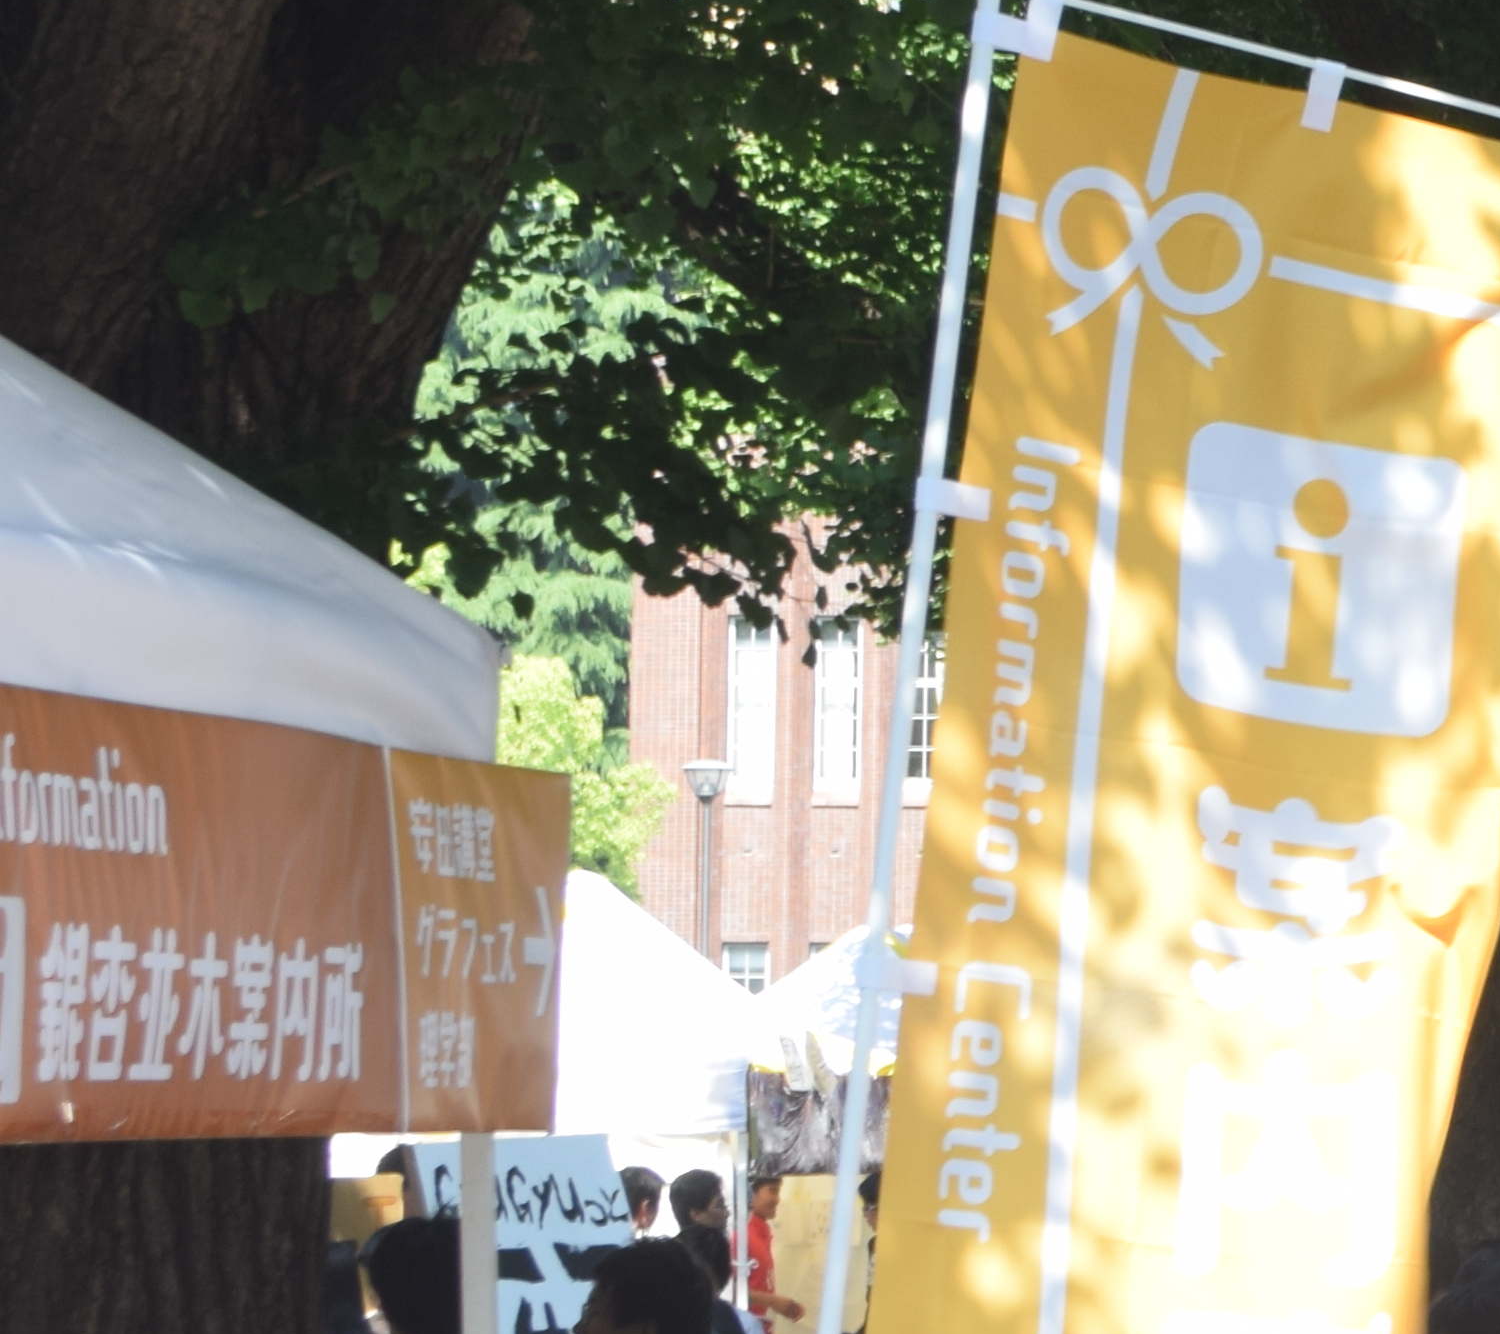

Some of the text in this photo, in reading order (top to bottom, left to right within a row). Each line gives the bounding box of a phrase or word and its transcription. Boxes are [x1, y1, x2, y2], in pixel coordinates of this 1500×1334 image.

[0, 732, 169, 857] formation
[408, 796, 497, 883] 安田講堂
[937, 435, 1081, 1244] Information Center
[37, 921, 365, 1084] 銀杏並木案内所
[416, 904, 517, 985] グラフェス
